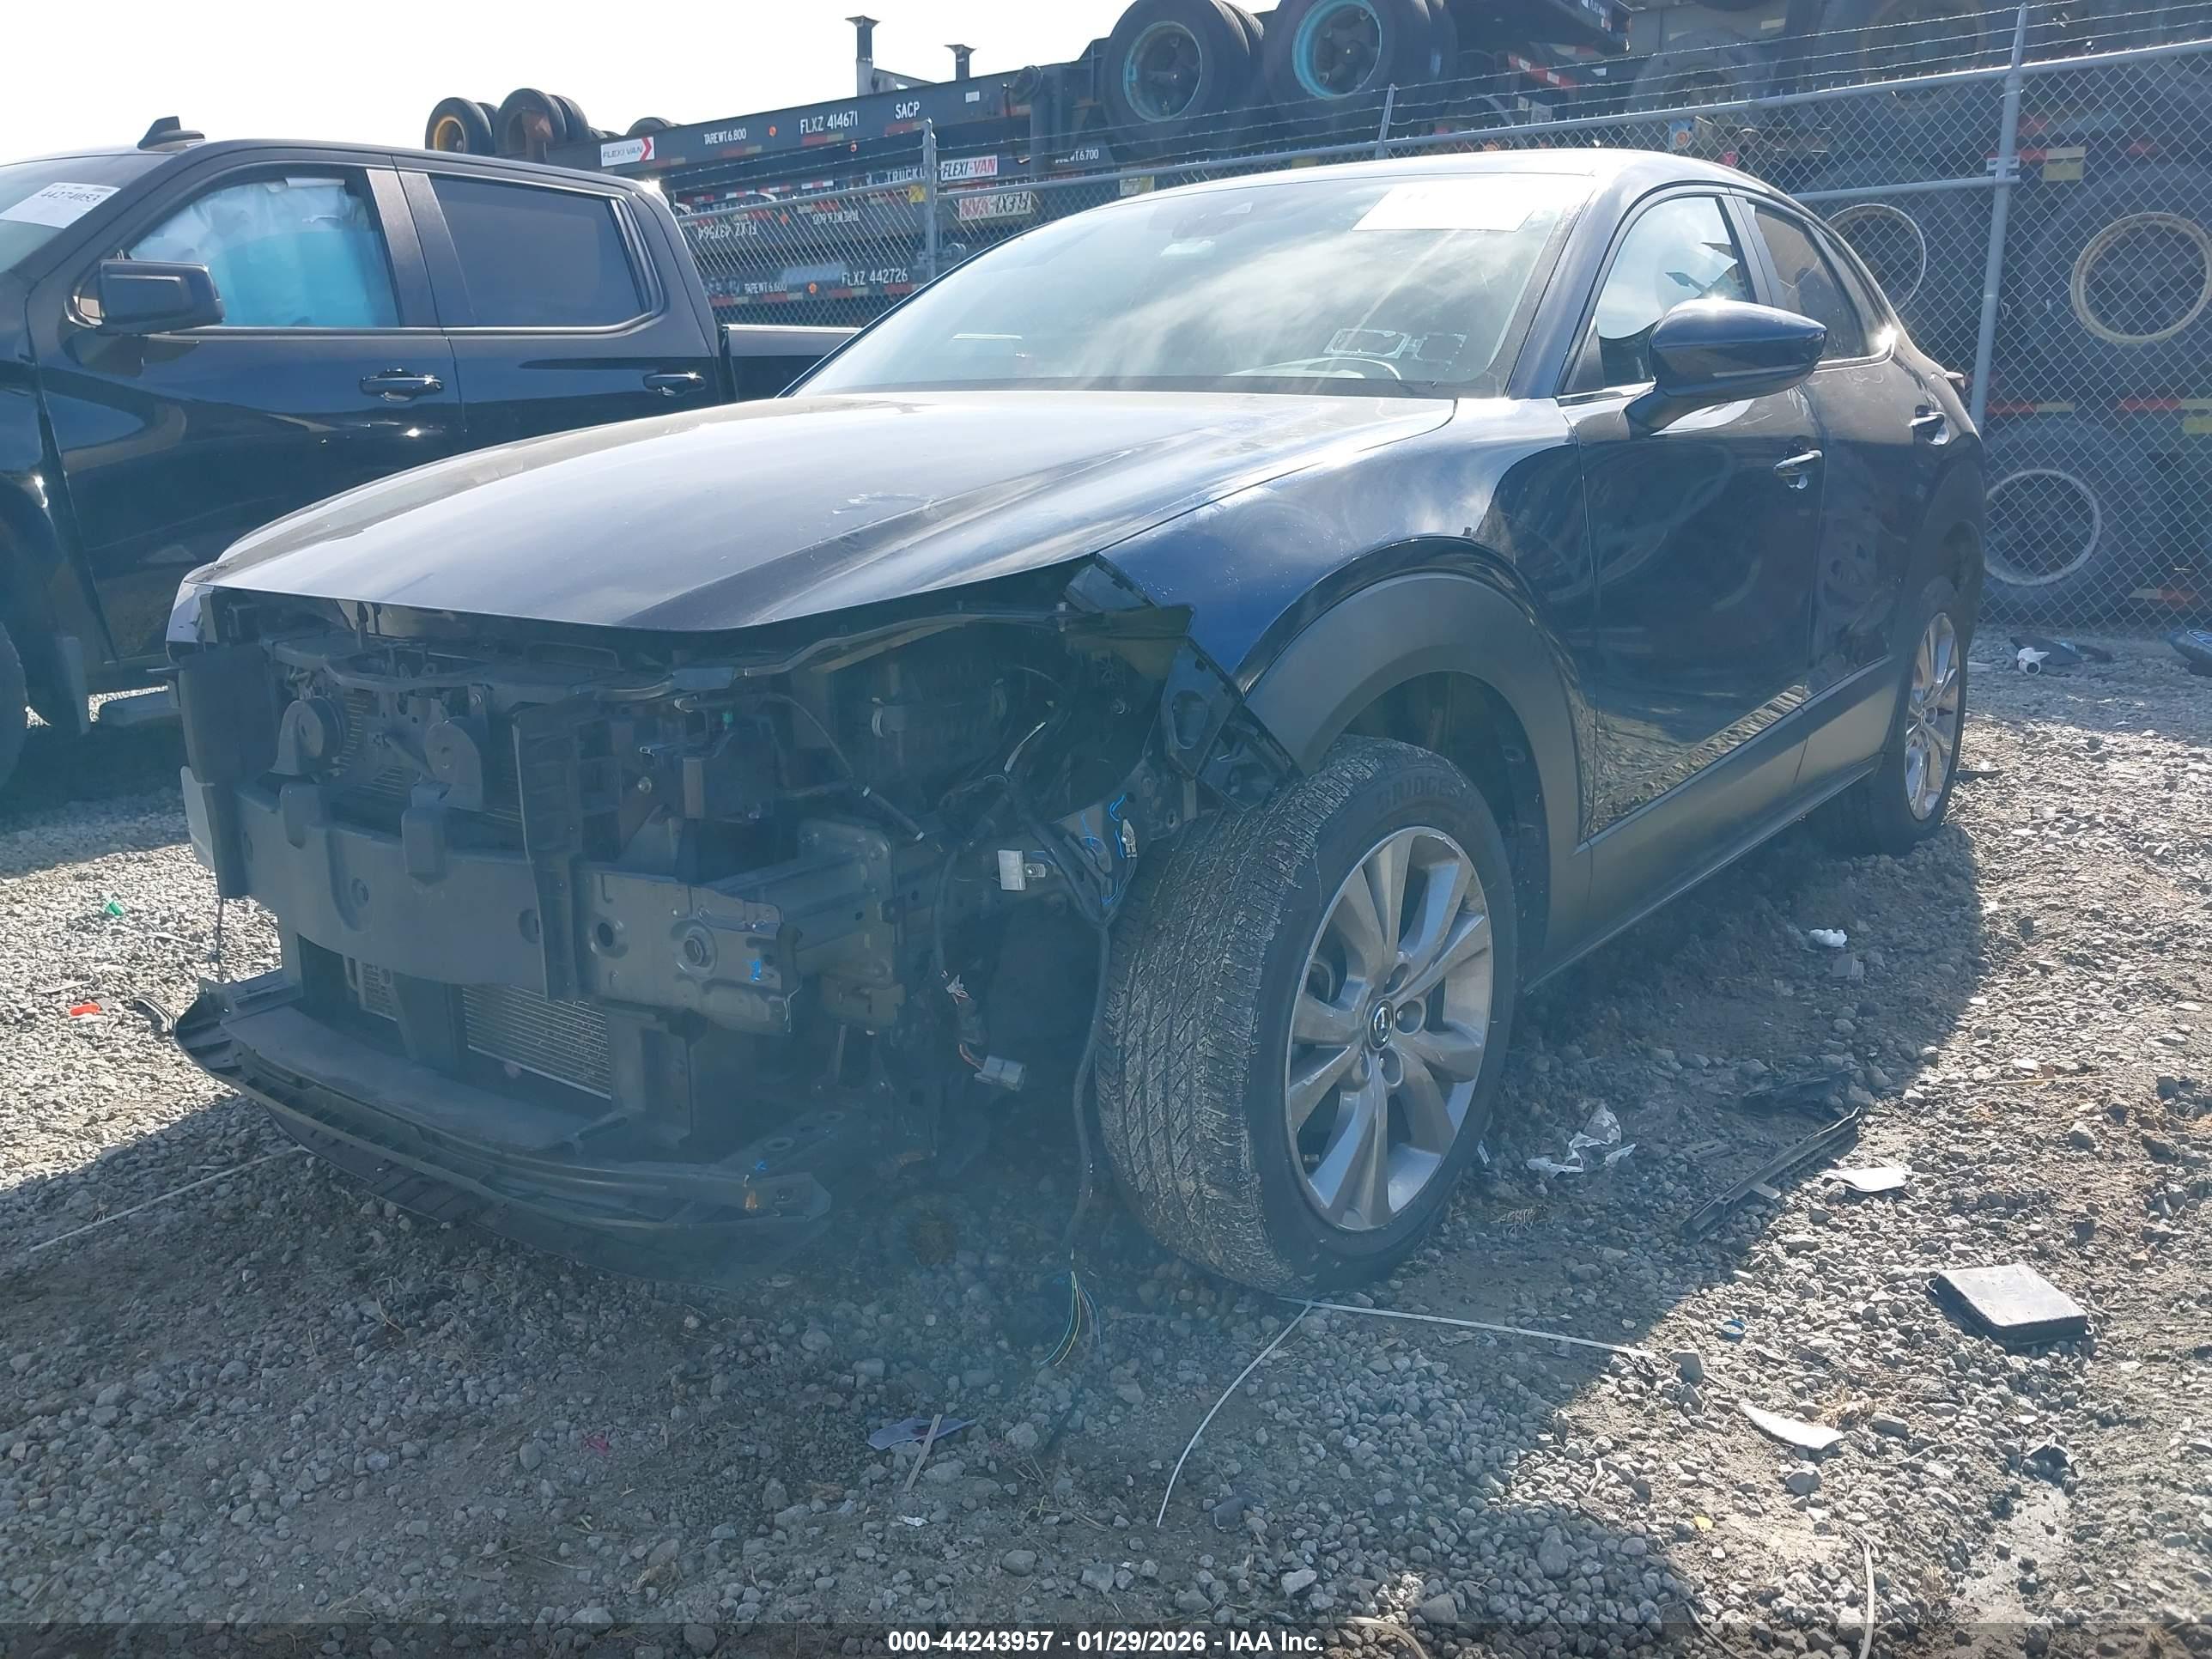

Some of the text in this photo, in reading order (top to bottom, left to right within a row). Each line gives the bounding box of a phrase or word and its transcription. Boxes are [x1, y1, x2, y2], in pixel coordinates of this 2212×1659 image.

[895, 101, 920, 119] SACP
[800, 110, 859, 135] FLXZ 414671
[943, 156, 996, 178] FLEXI-VAN
[869, 268, 908, 284] 442726
